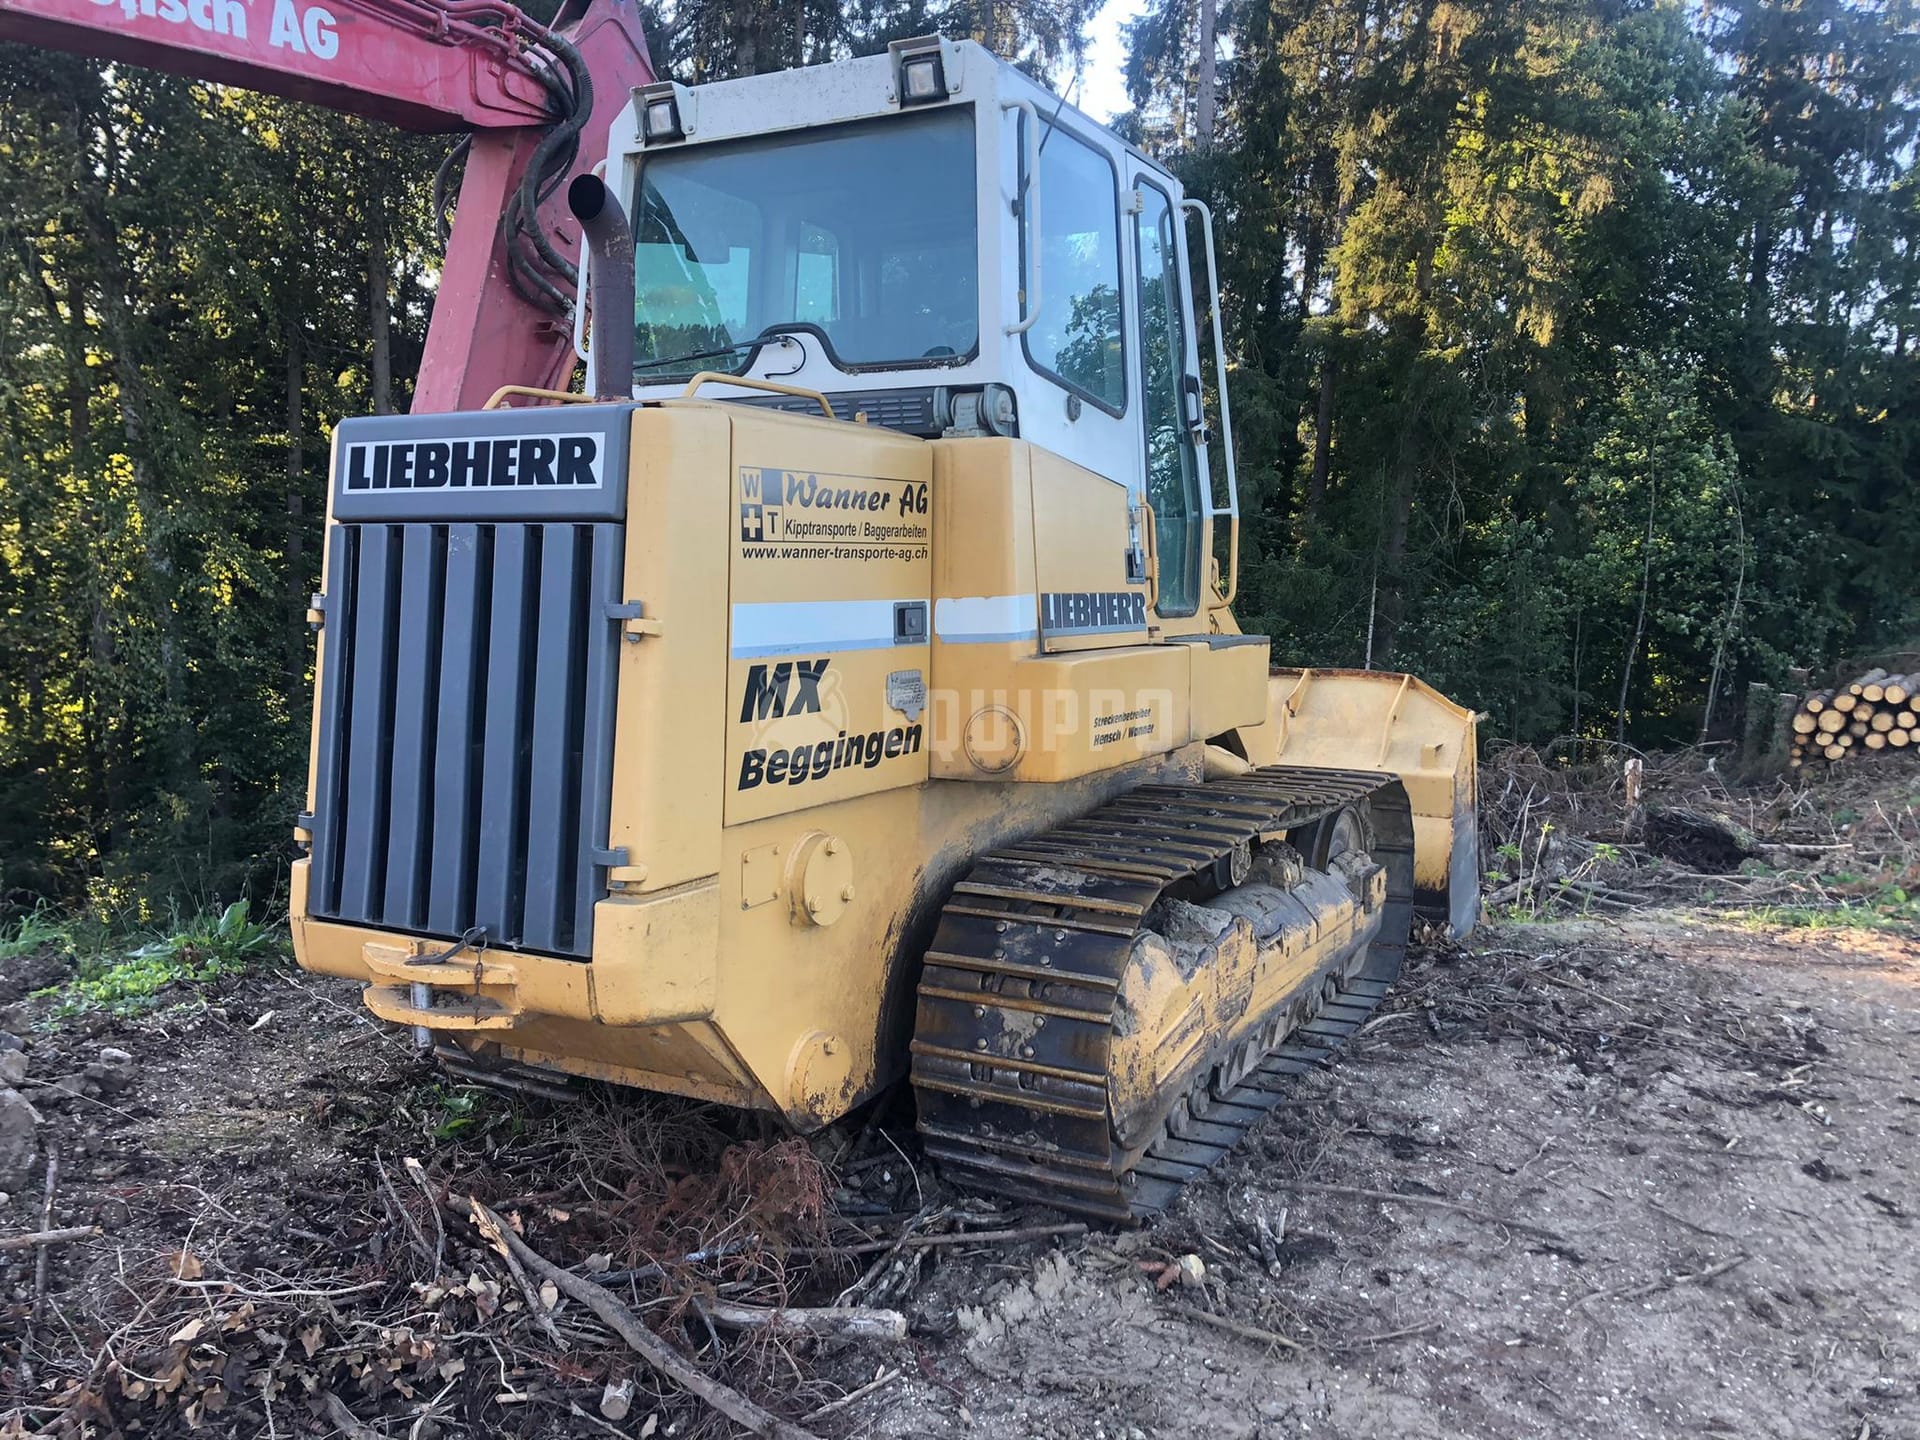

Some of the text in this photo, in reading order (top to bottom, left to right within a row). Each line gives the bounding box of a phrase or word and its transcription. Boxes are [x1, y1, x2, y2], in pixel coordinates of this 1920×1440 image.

[269, 1, 339, 60] AG
[348, 437, 597, 489] LIEBHERR
[743, 473, 760, 498] W
[786, 473, 928, 517] Wanner AG
[767, 512, 778, 534] T
[785, 519, 857, 540] Kipptransporte
[864, 522, 927, 541] Baggerarbeiten
[742, 546, 928, 562] www.wanner-transporte-ag.ch
[1040, 592, 1146, 629] LIEBHERR
[740, 658, 831, 723] MX
[1093, 708, 1151, 728] Streckenbetreiber
[1093, 729, 1121, 746] Hensch
[738, 724, 922, 791] Beggingen
